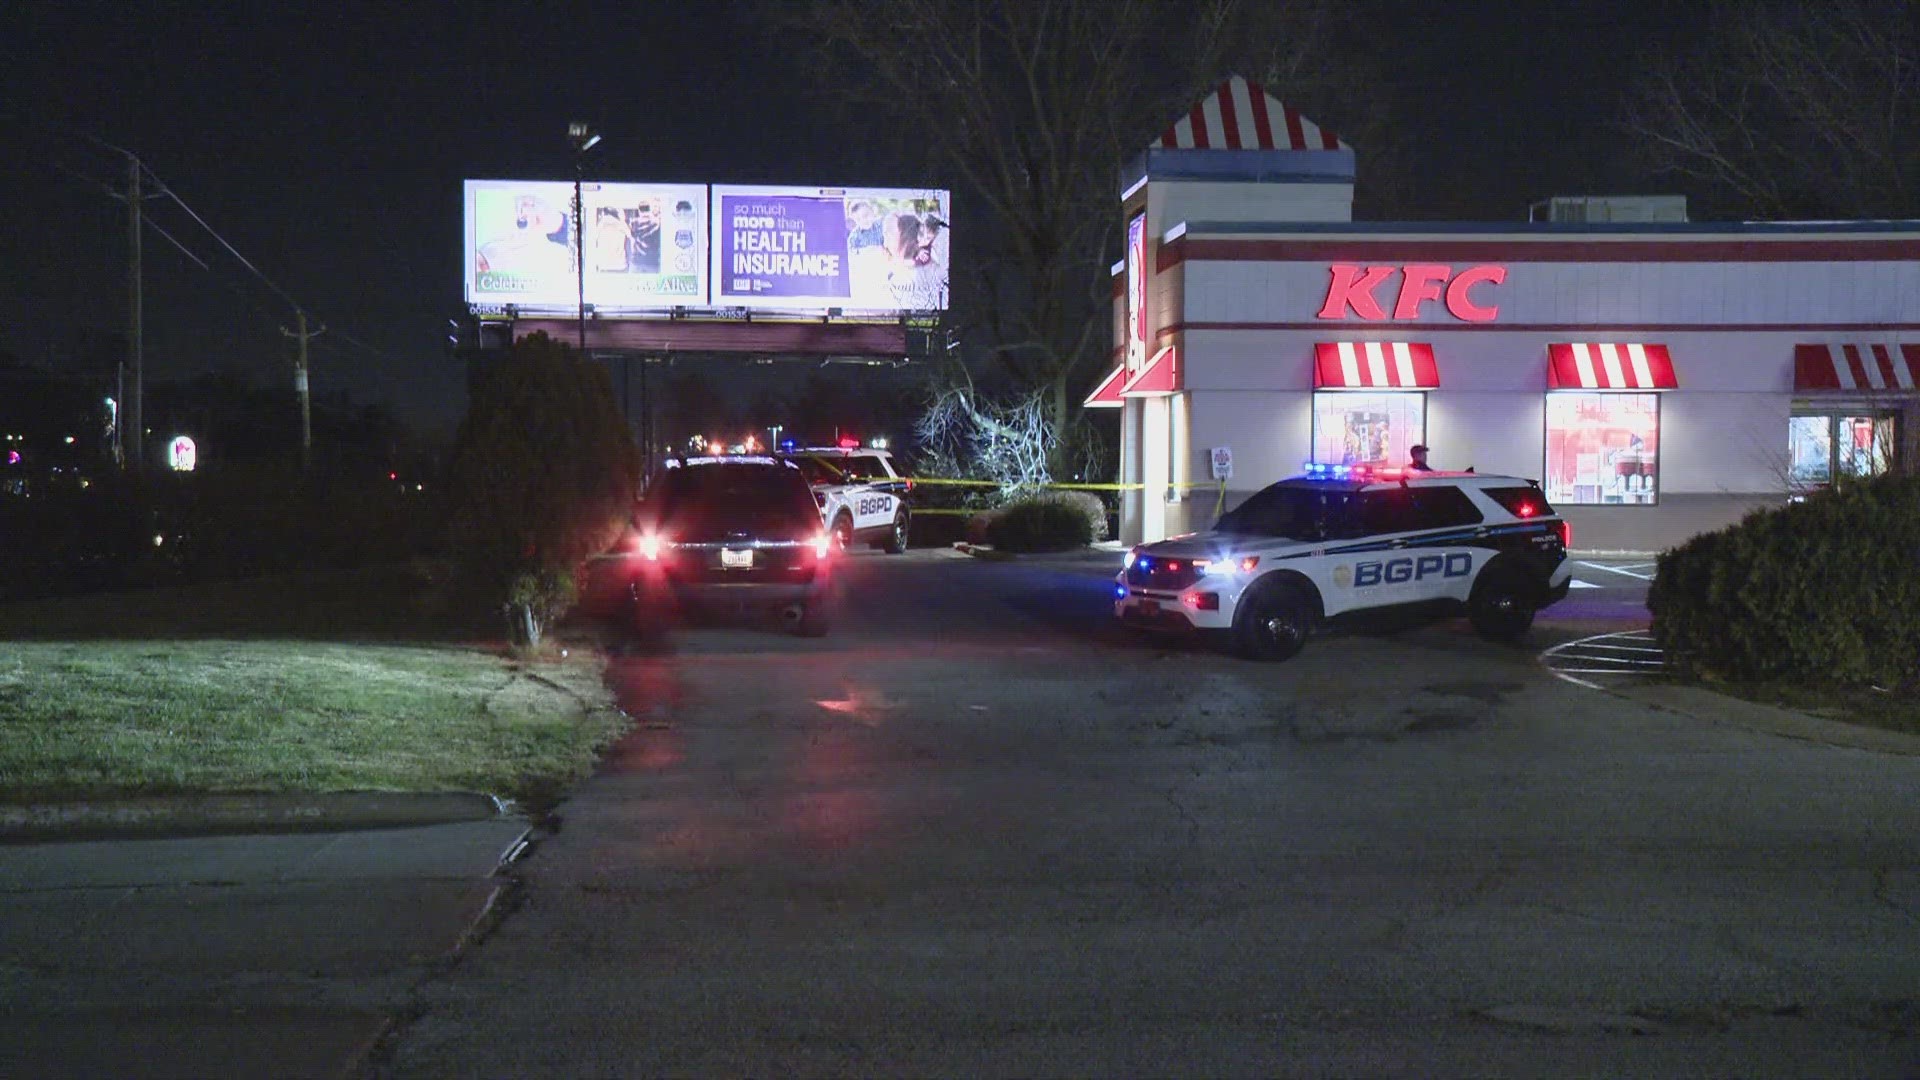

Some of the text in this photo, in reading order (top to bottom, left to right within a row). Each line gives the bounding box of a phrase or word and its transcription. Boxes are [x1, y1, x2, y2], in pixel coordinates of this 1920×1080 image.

[734, 203, 786, 215] so much
[733, 216, 805, 230] more than
[733, 230, 806, 253] HEALTH
[733, 253, 840, 277] INSURANCE
[1317, 264, 1507, 321] KFC
[860, 496, 893, 516] BGPD
[1353, 551, 1473, 588] BGPD
